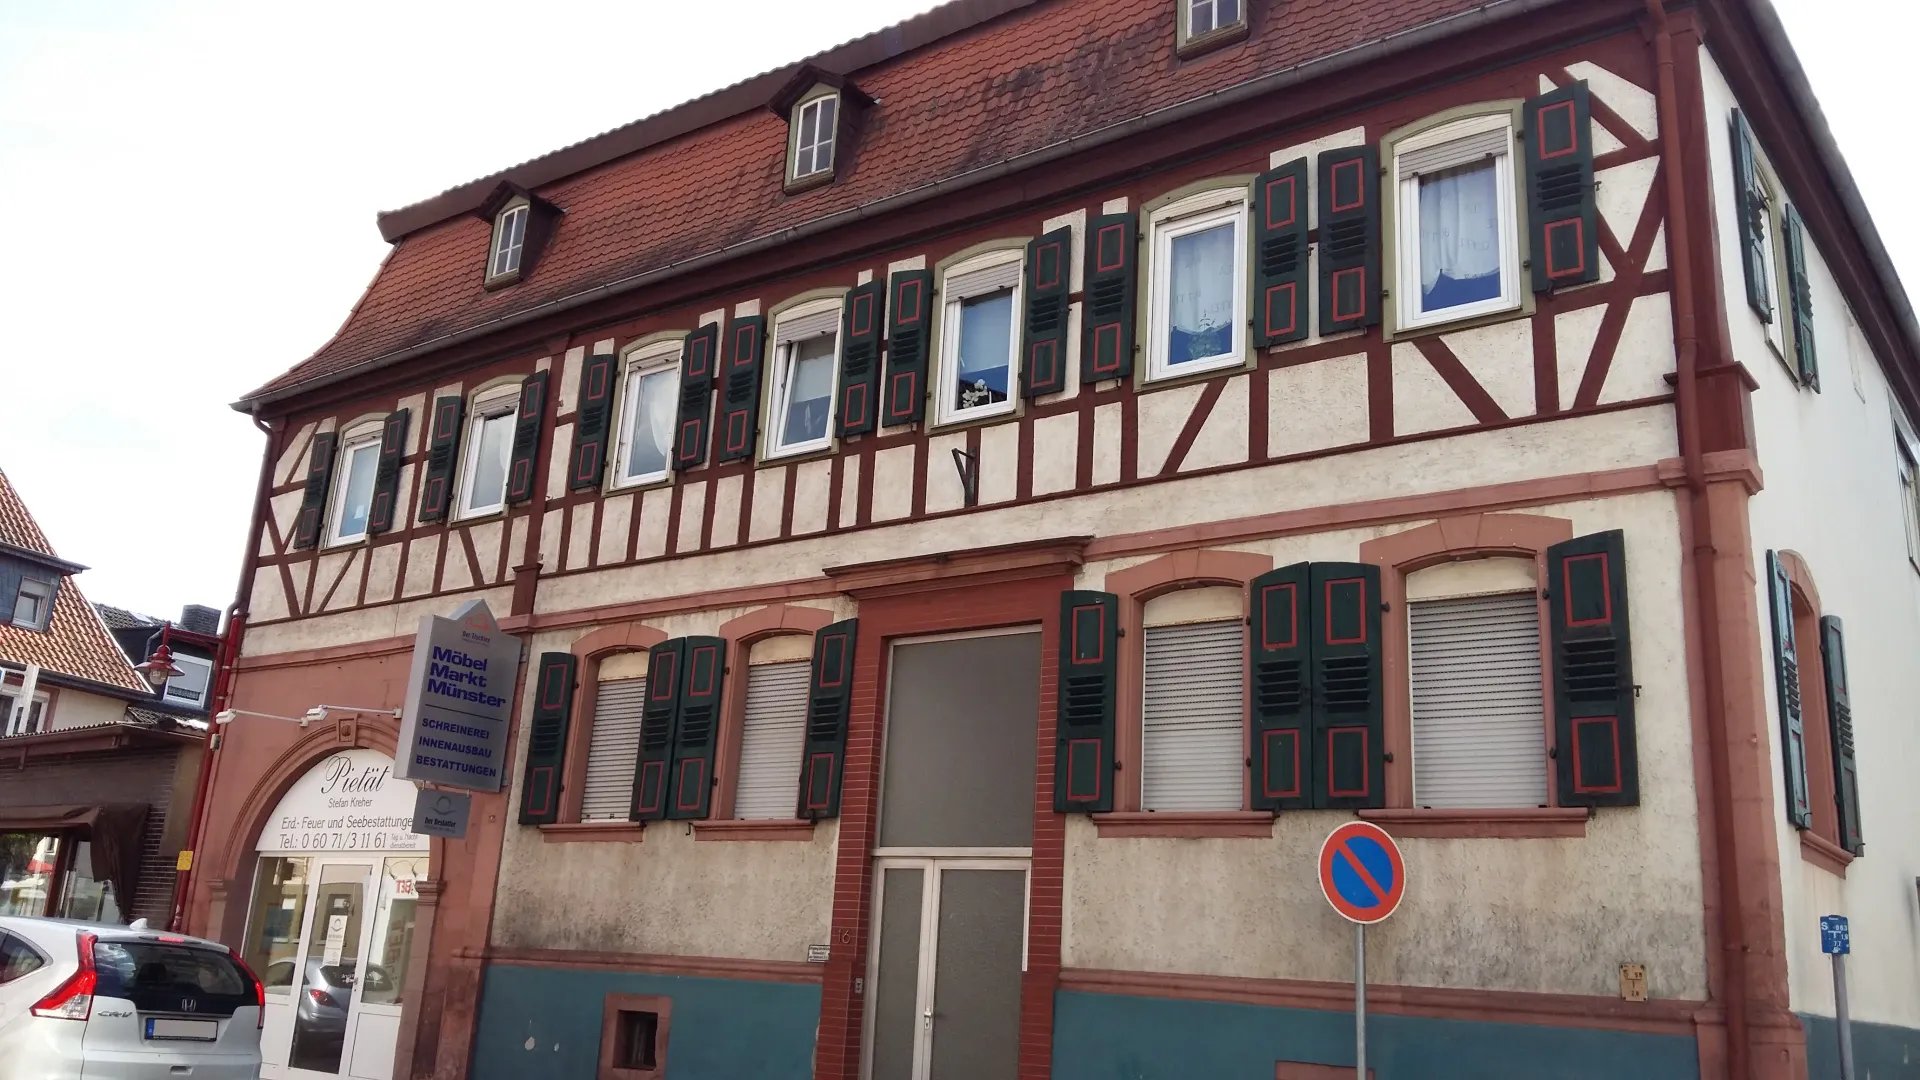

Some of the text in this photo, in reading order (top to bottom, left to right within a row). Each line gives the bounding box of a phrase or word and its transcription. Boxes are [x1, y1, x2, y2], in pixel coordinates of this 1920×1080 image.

[432, 645, 488, 672] Möbel
[430, 662, 487, 688] Markt
[427, 678, 506, 708] Münster
[422, 718, 490, 740] SCHREINEREI
[419, 736, 492, 758] INNENAUSBAU
[321, 755, 390, 794] Pietät
[416, 754, 497, 777] BESTATTUNGEN
[328, 798, 372, 808] Stefan Kreher
[301, 817, 325, 829] Feuer
[327, 816, 344, 829] und
[346, 815, 413, 831] Seebestattunge
[279, 834, 298, 849] Tel.:
[301, 833, 309, 849] 0
[312, 833, 328, 849] 60
[374, 832, 388, 848] 61
[838, 928, 851, 944] 16
